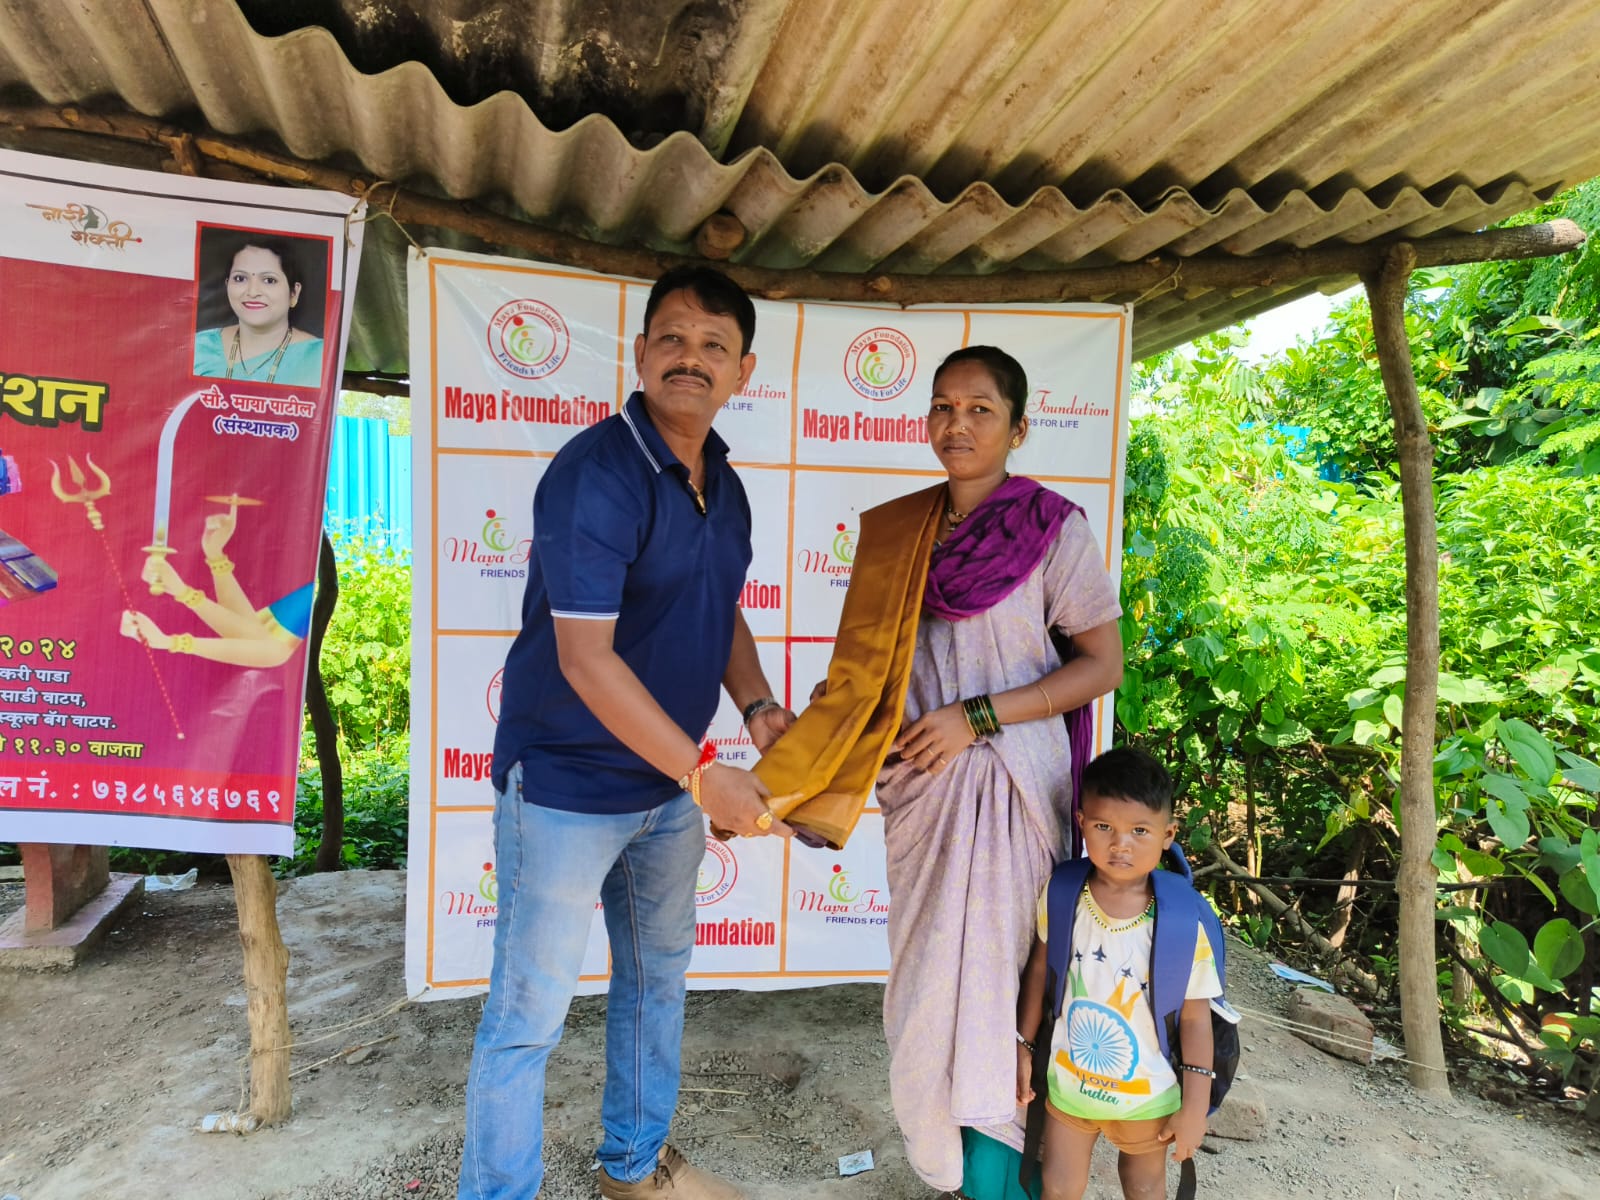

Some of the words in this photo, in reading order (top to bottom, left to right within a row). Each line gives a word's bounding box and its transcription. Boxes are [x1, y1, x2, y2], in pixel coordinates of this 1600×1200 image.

[494, 308, 515, 329] Maya
[516, 302, 563, 334] Foundation
[850, 335, 873, 356] Maya
[873, 331, 911, 359] Foundation
[498, 352, 529, 376] Friends
[545, 353, 561, 370] Life
[851, 376, 879, 398] Friends
[880, 389, 894, 398] For
[894, 377, 908, 393] Life
[199, 385, 229, 409] सौ.
[231, 394, 266, 414] माया
[268, 395, 317, 418] पाटील
[444, 386, 497, 424] Maya
[501, 389, 610, 427] Foundation
[732, 401, 753, 412] LIFE
[1025, 389, 1110, 416] Foundation
[213, 413, 299, 441] (संस्थापक)
[803, 408, 850, 443] Maya
[854, 411, 929, 444] Foundati
[1039, 419, 1058, 428] FOR
[1060, 420, 1080, 429] LIFE
[443, 537, 505, 567] Maya
[798, 548, 853, 577] Maya
[480, 568, 526, 578] FRIENDS
[830, 578, 851, 588] FRIE
[34, 668, 71, 684] पाडा
[41, 691, 87, 708] वाटप,
[70, 715, 118, 729] वाटप.
[88, 741, 144, 758] वाजता
[727, 751, 748, 761] LIFE
[444, 748, 494, 781] Maya
[701, 893, 716, 903] For
[715, 882, 730, 897] Life
[793, 889, 848, 915] Maya
[695, 917, 776, 946] undation
[825, 915, 867, 925] FRIENDS
